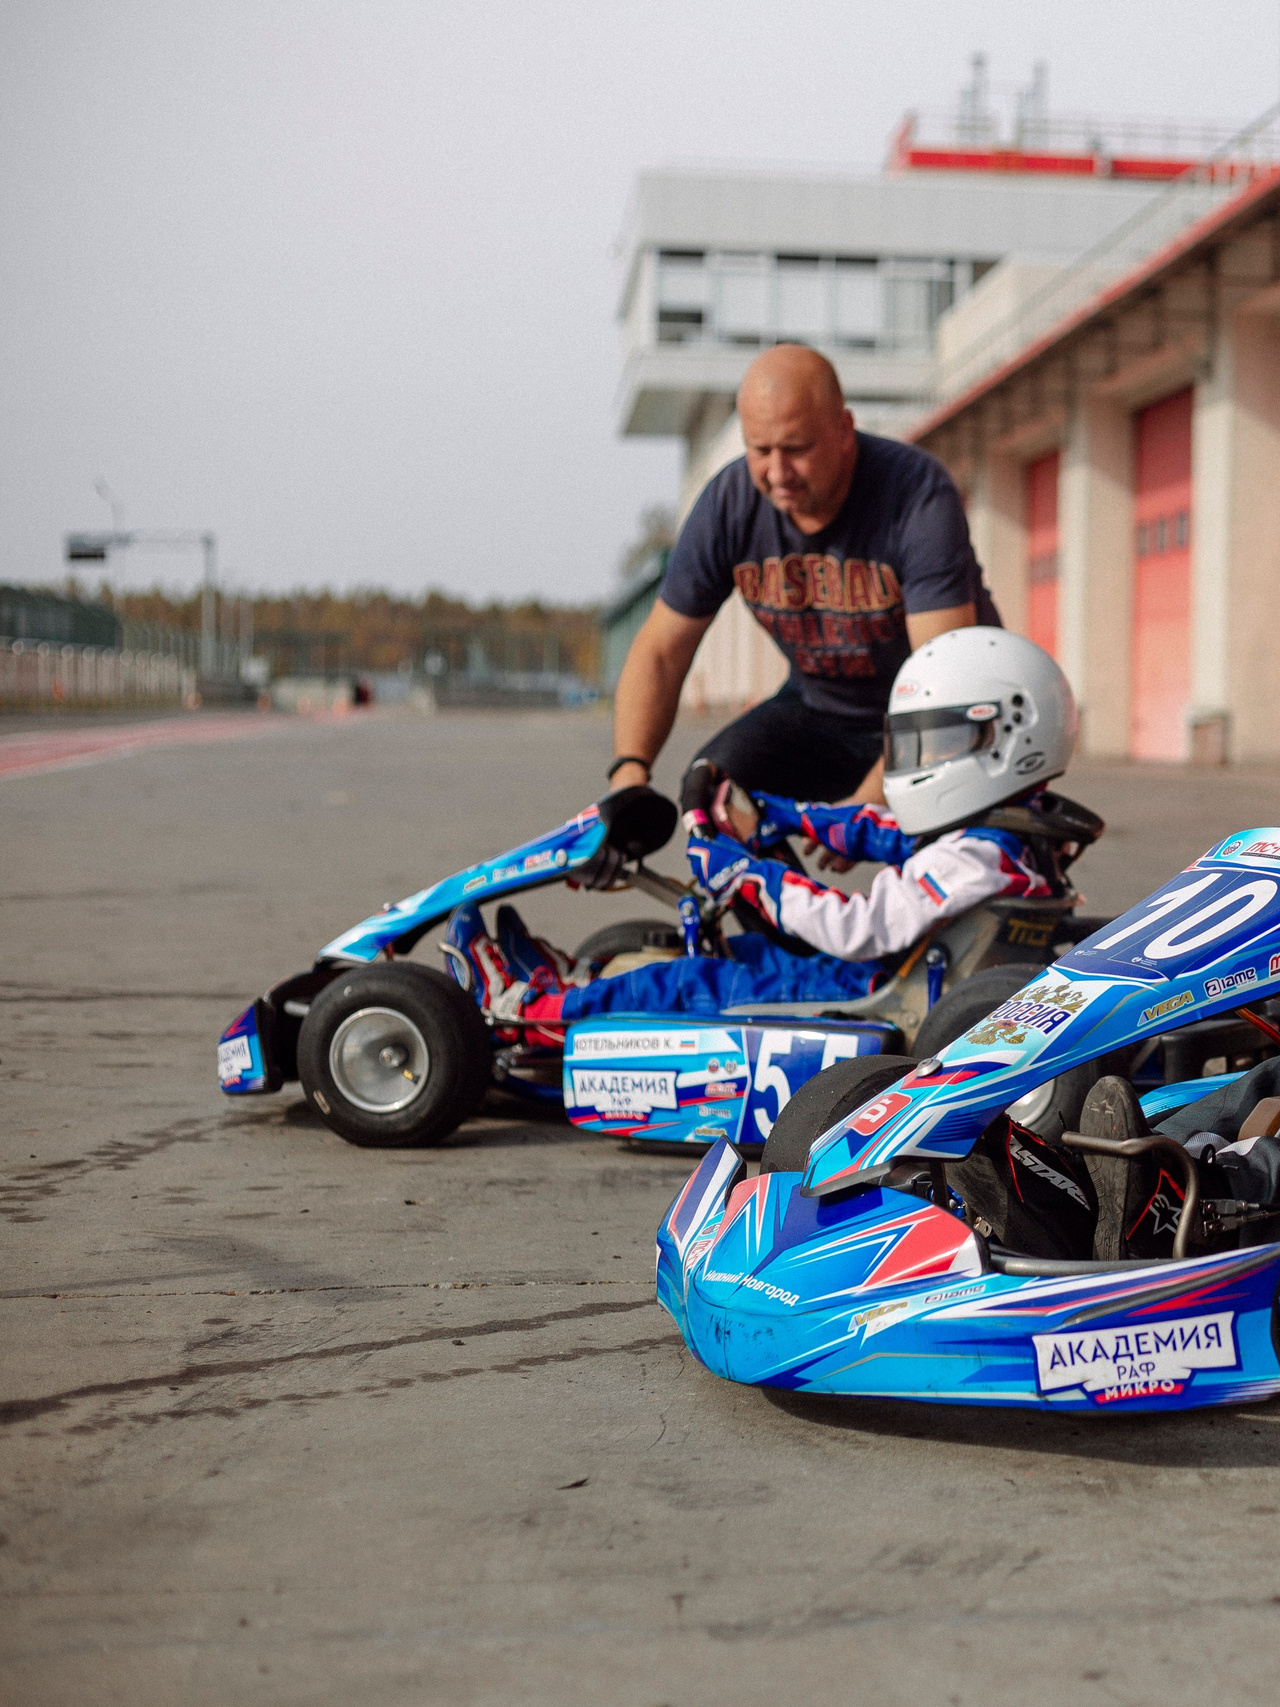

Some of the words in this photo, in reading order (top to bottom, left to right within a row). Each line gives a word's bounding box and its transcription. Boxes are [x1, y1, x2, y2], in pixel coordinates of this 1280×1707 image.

[1093, 873, 1279, 960] 10
[1143, 990, 1194, 1021] VEGA
[580, 1076, 668, 1095] АКАДЕМИЯ
[703, 1270, 744, 1284] Нижний
[738, 1274, 800, 1307] Новгород
[856, 1301, 908, 1326] VEGA
[1050, 1322, 1223, 1370] АКАДЕМИЯ
[1116, 1361, 1156, 1381] РАФ
[1104, 1379, 1175, 1401] МИКРО
